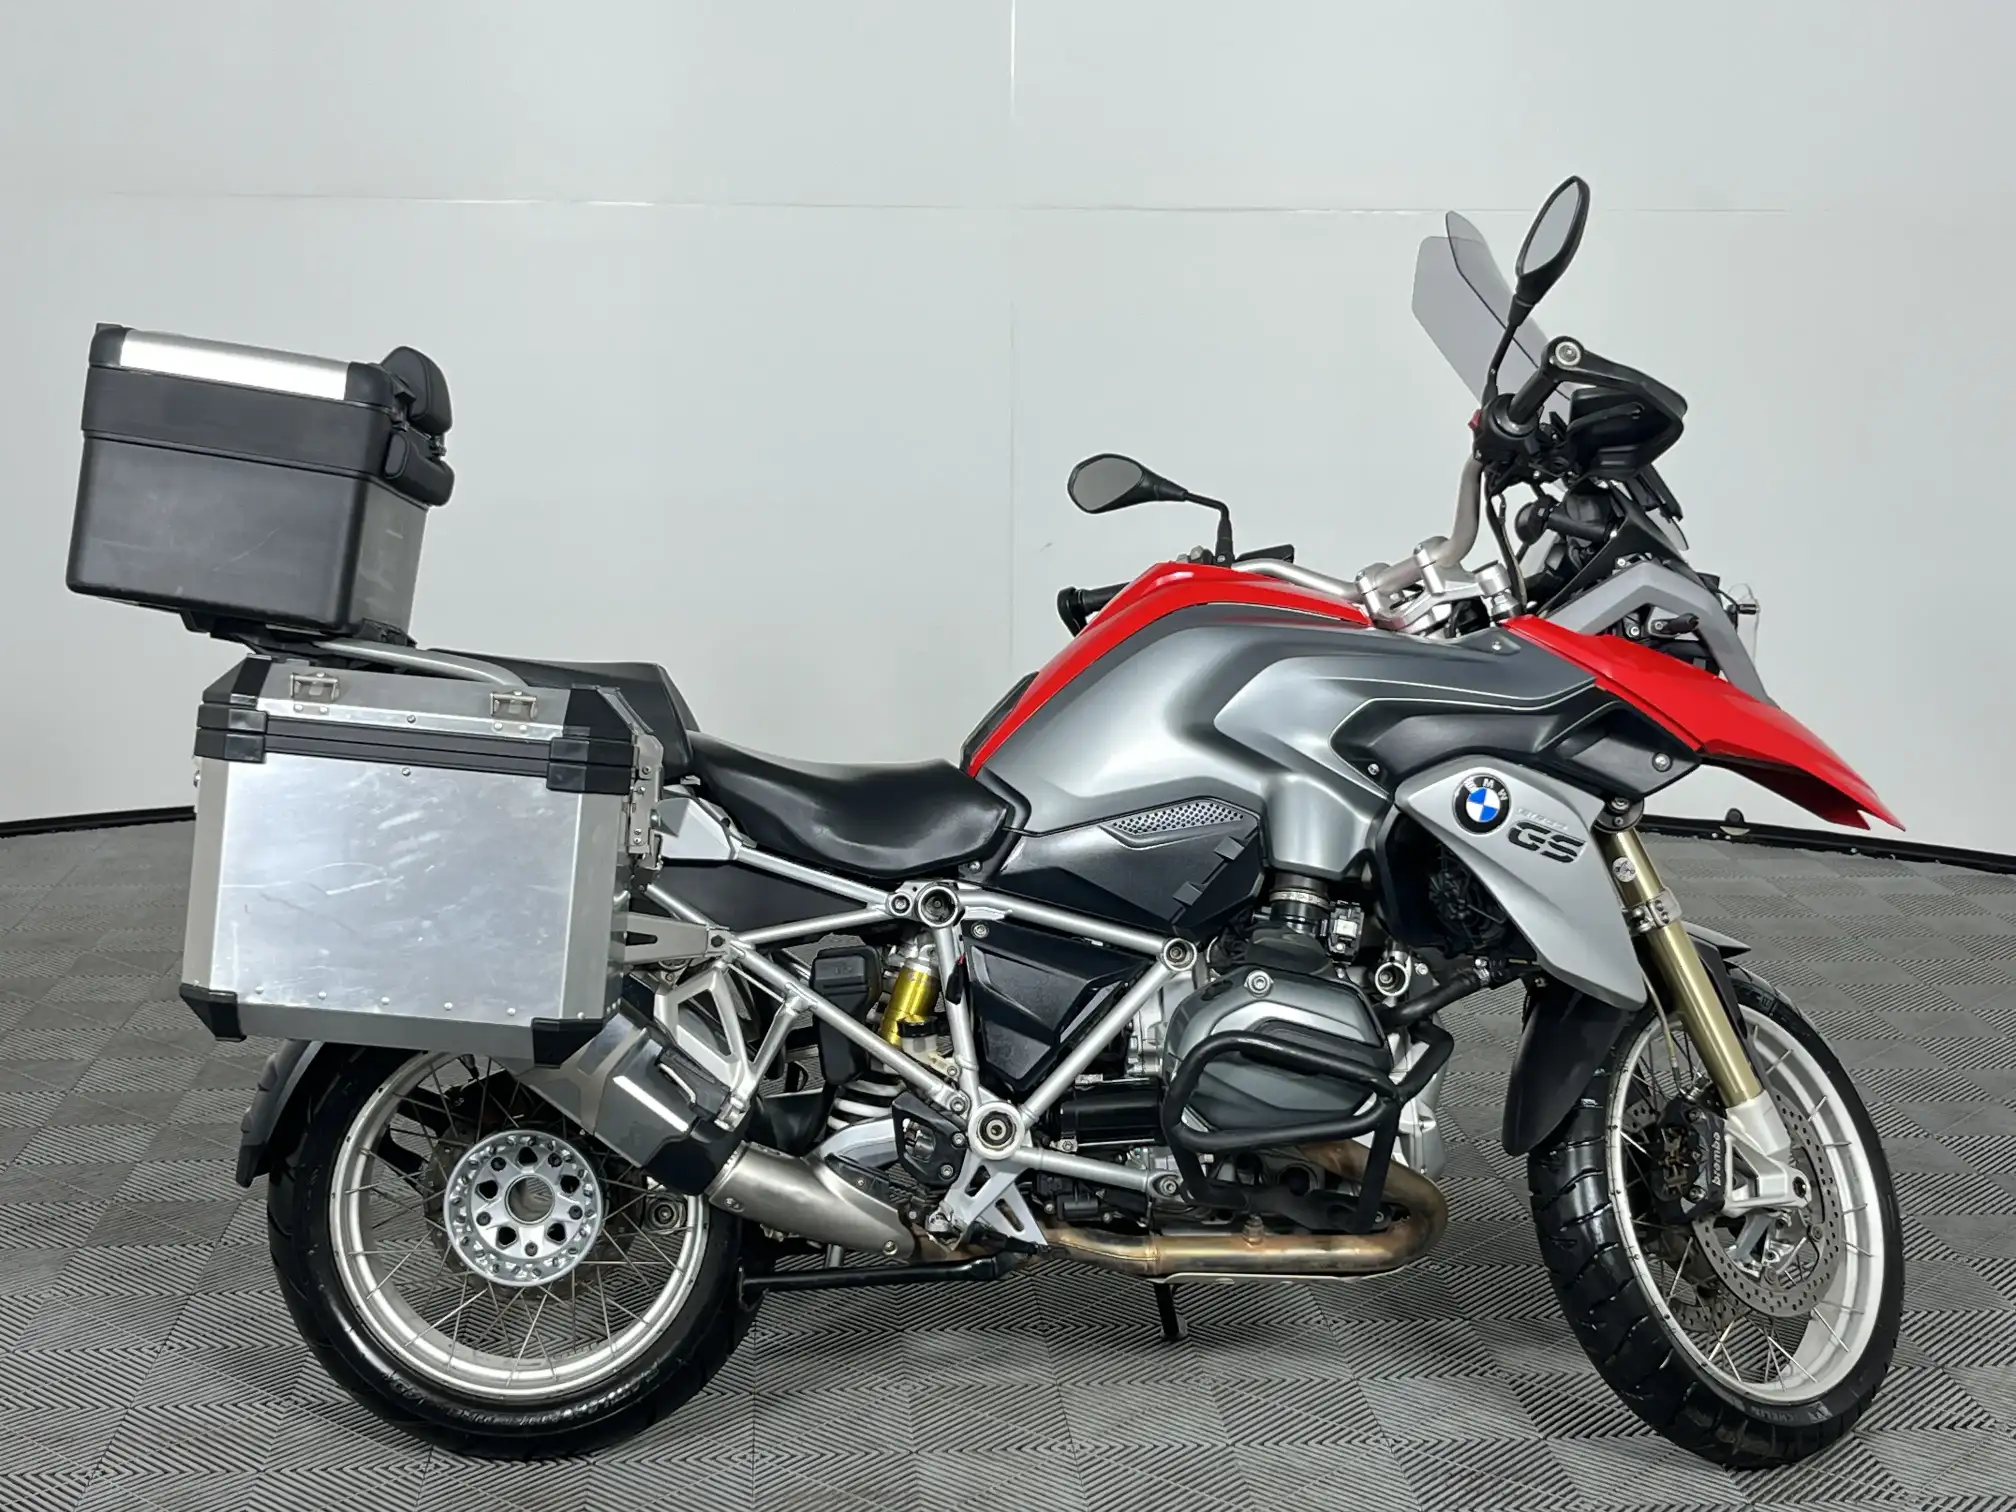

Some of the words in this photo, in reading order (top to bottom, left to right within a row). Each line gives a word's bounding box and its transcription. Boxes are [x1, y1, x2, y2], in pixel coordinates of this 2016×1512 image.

[1464, 778, 1508, 801] BMW
[1508, 820, 1587, 864] GS
[1711, 1131, 1721, 1186] brembo
